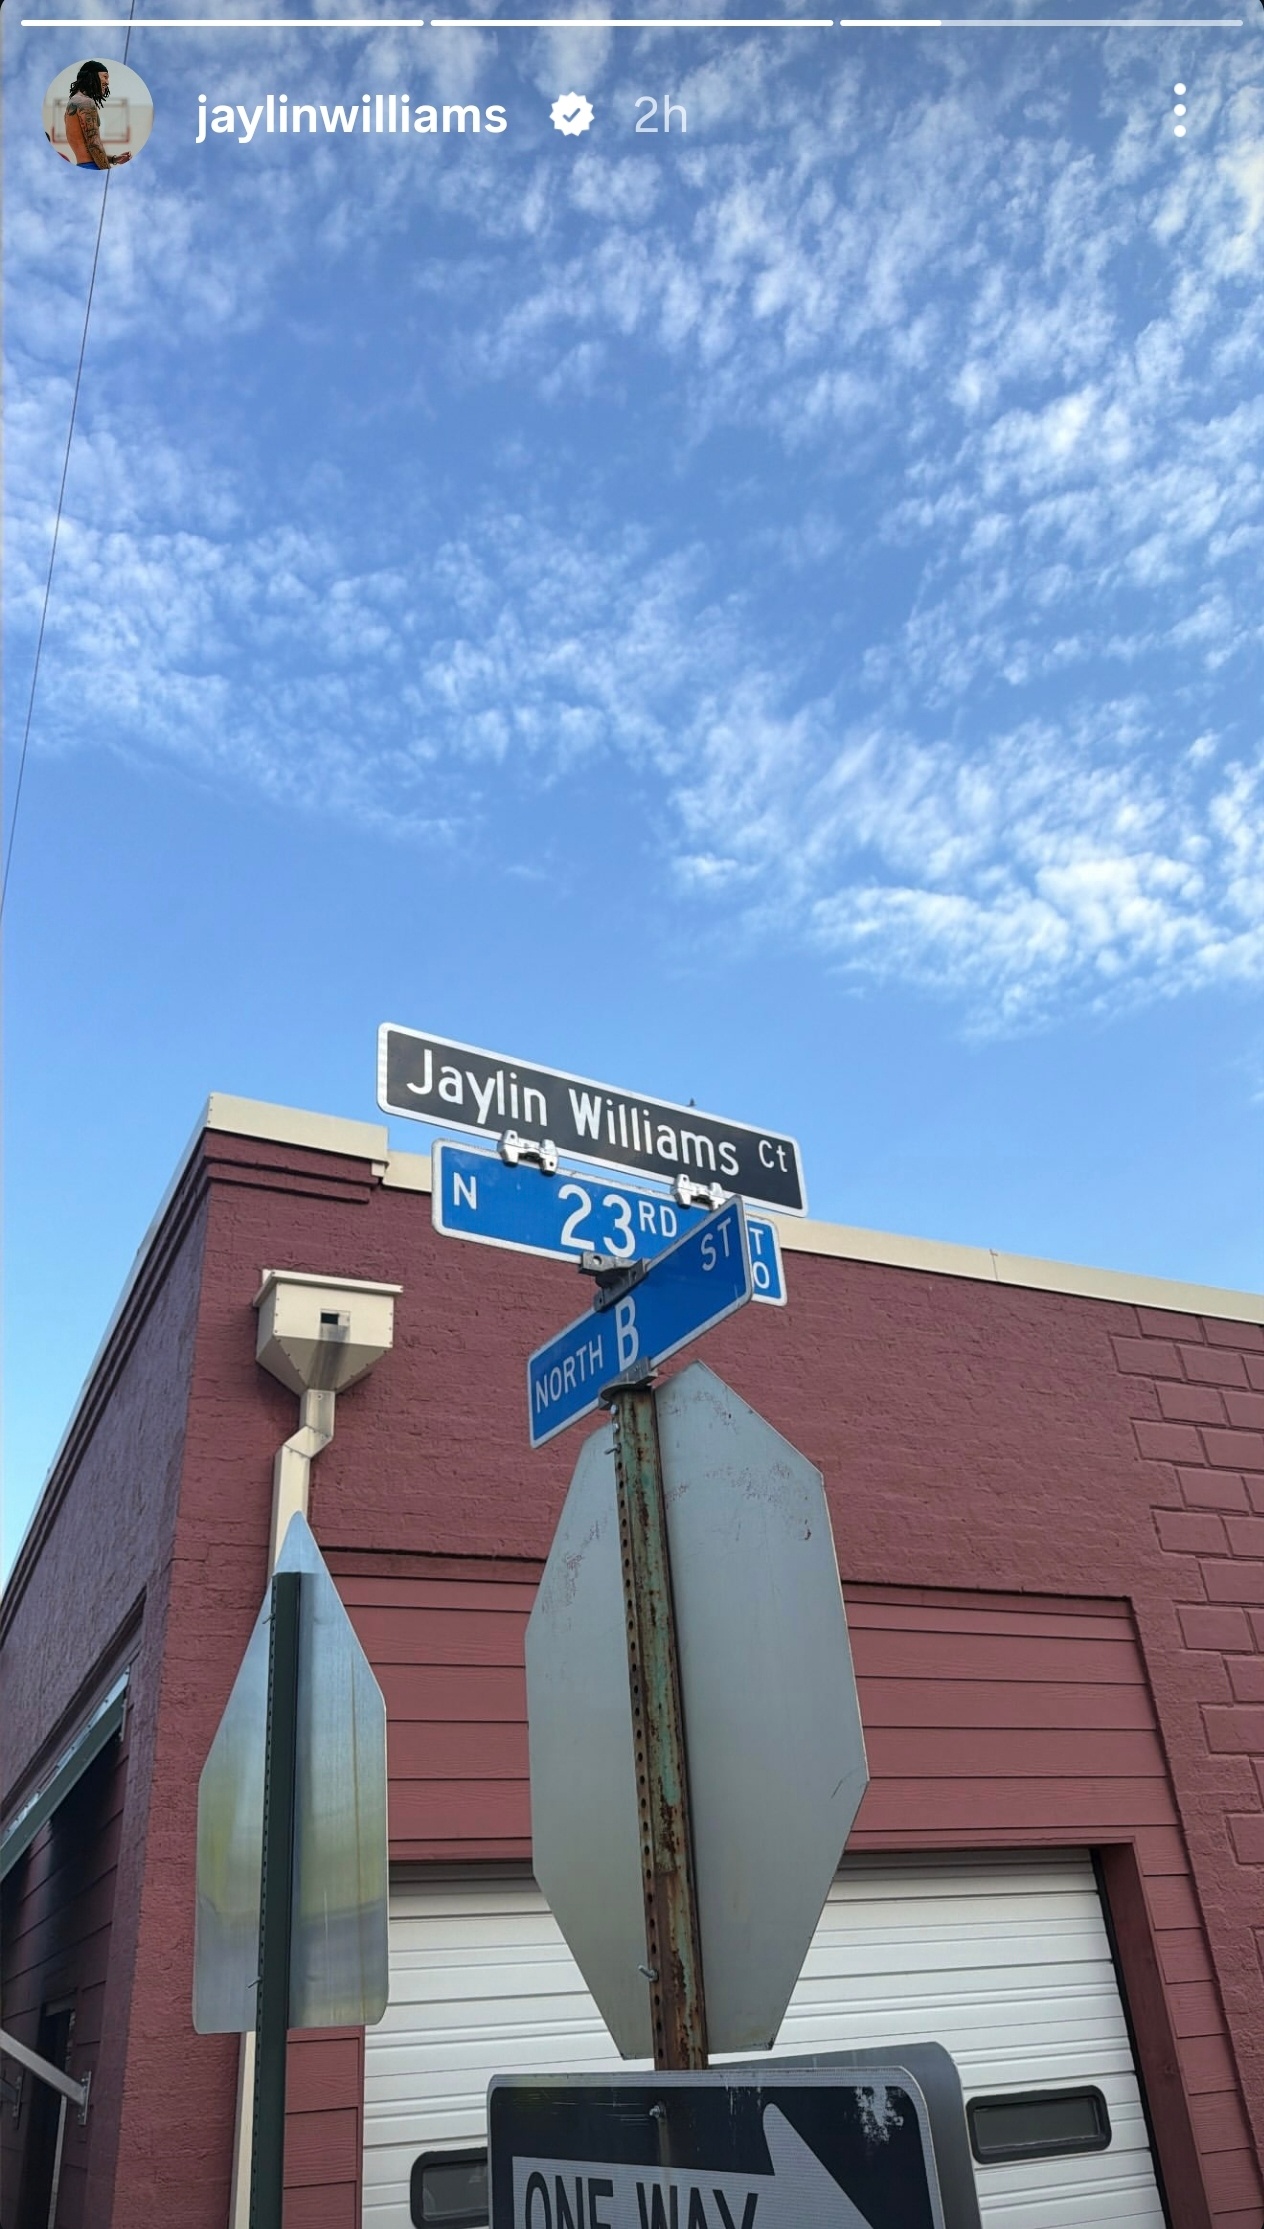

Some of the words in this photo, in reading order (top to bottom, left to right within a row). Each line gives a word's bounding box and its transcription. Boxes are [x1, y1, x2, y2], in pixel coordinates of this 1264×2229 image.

[407, 1049, 548, 1126] Jaylin
[568, 1087, 739, 1176] Williams
[758, 1139, 788, 1173] Ct
[453, 1172, 478, 1211] N
[536, 1334, 604, 1414] NORTH
[614, 1295, 639, 1372] B
[701, 1217, 731, 1271] ST
[525, 2171, 614, 2229] ONE
